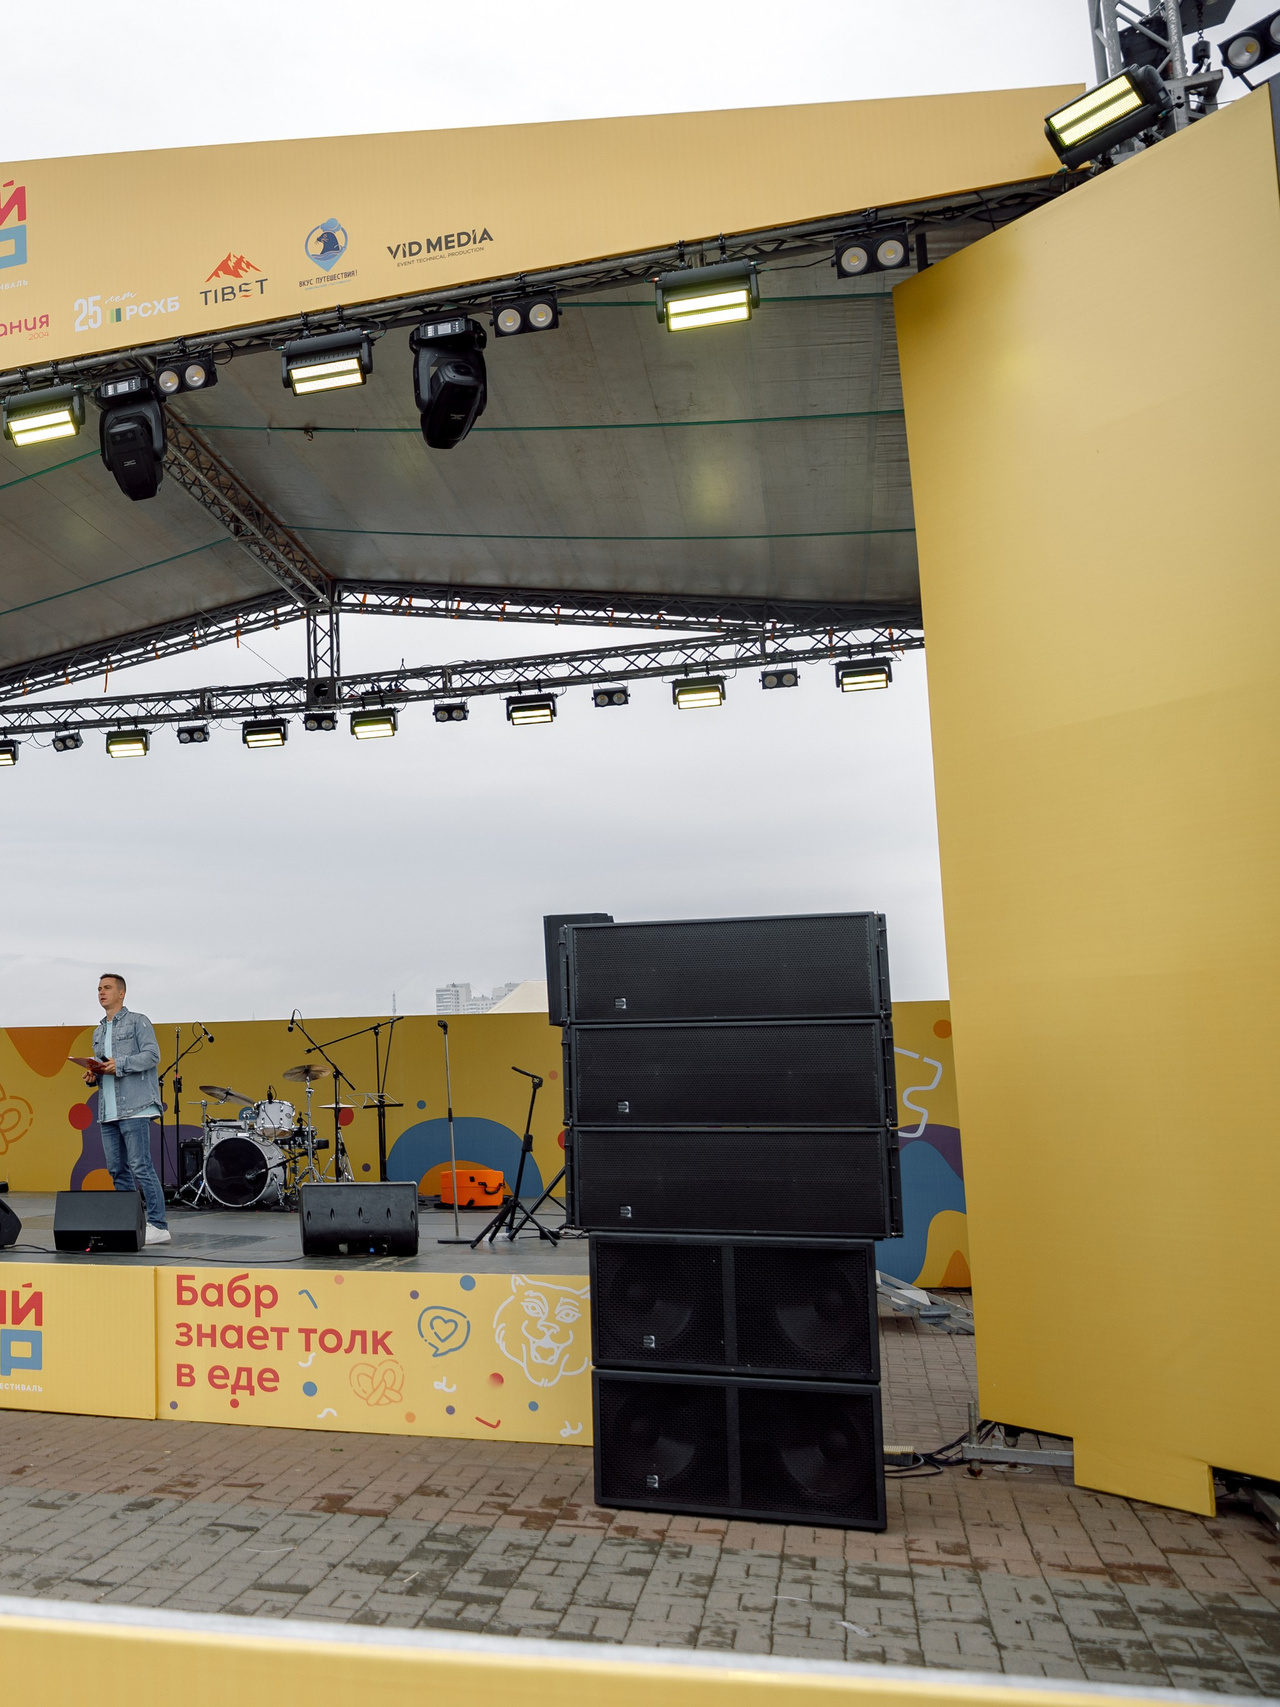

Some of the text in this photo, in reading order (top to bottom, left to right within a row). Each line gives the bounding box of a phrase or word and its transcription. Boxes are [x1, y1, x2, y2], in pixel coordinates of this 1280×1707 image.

[397, 246, 484, 268] EVENT TECHNICAL PRODUCTION
[199, 278, 269, 306] TIBET
[298, 278, 314, 288] ВКУС
[74, 295, 102, 332] 25
[126, 296, 180, 321] РСХБ
[28, 330, 50, 341] 2004
[176, 1273, 278, 1318] Бабр
[175, 1322, 394, 1355] знает толк
[176, 1363, 280, 1396] в еде
